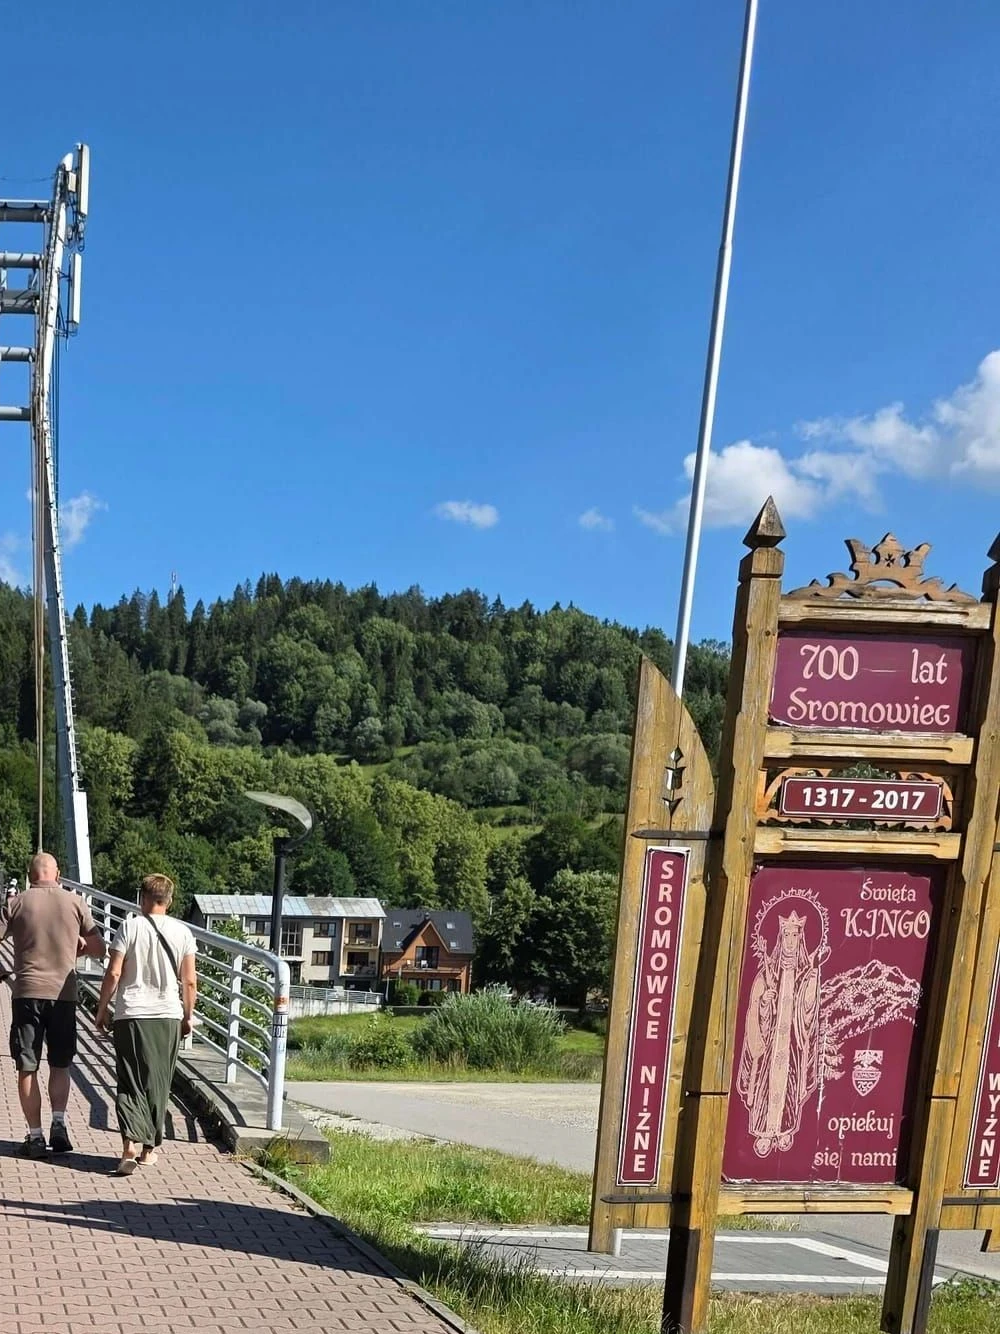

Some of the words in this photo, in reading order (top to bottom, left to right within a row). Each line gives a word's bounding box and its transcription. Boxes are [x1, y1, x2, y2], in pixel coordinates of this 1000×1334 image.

[800, 644, 859, 681] 700
[911, 648, 948, 684] lat
[787, 687, 950, 726] Sromowiec
[802, 787, 855, 808] 1317
[871, 789, 926, 811] 2017
[860, 877, 916, 904] Święta
[646, 859, 675, 1040] SROMOWCE
[633, 1065, 656, 1173] NIŻNE
[828, 1110, 894, 1139] opiekuj
[813, 1147, 840, 1168] się
[851, 1147, 897, 1166] nami
